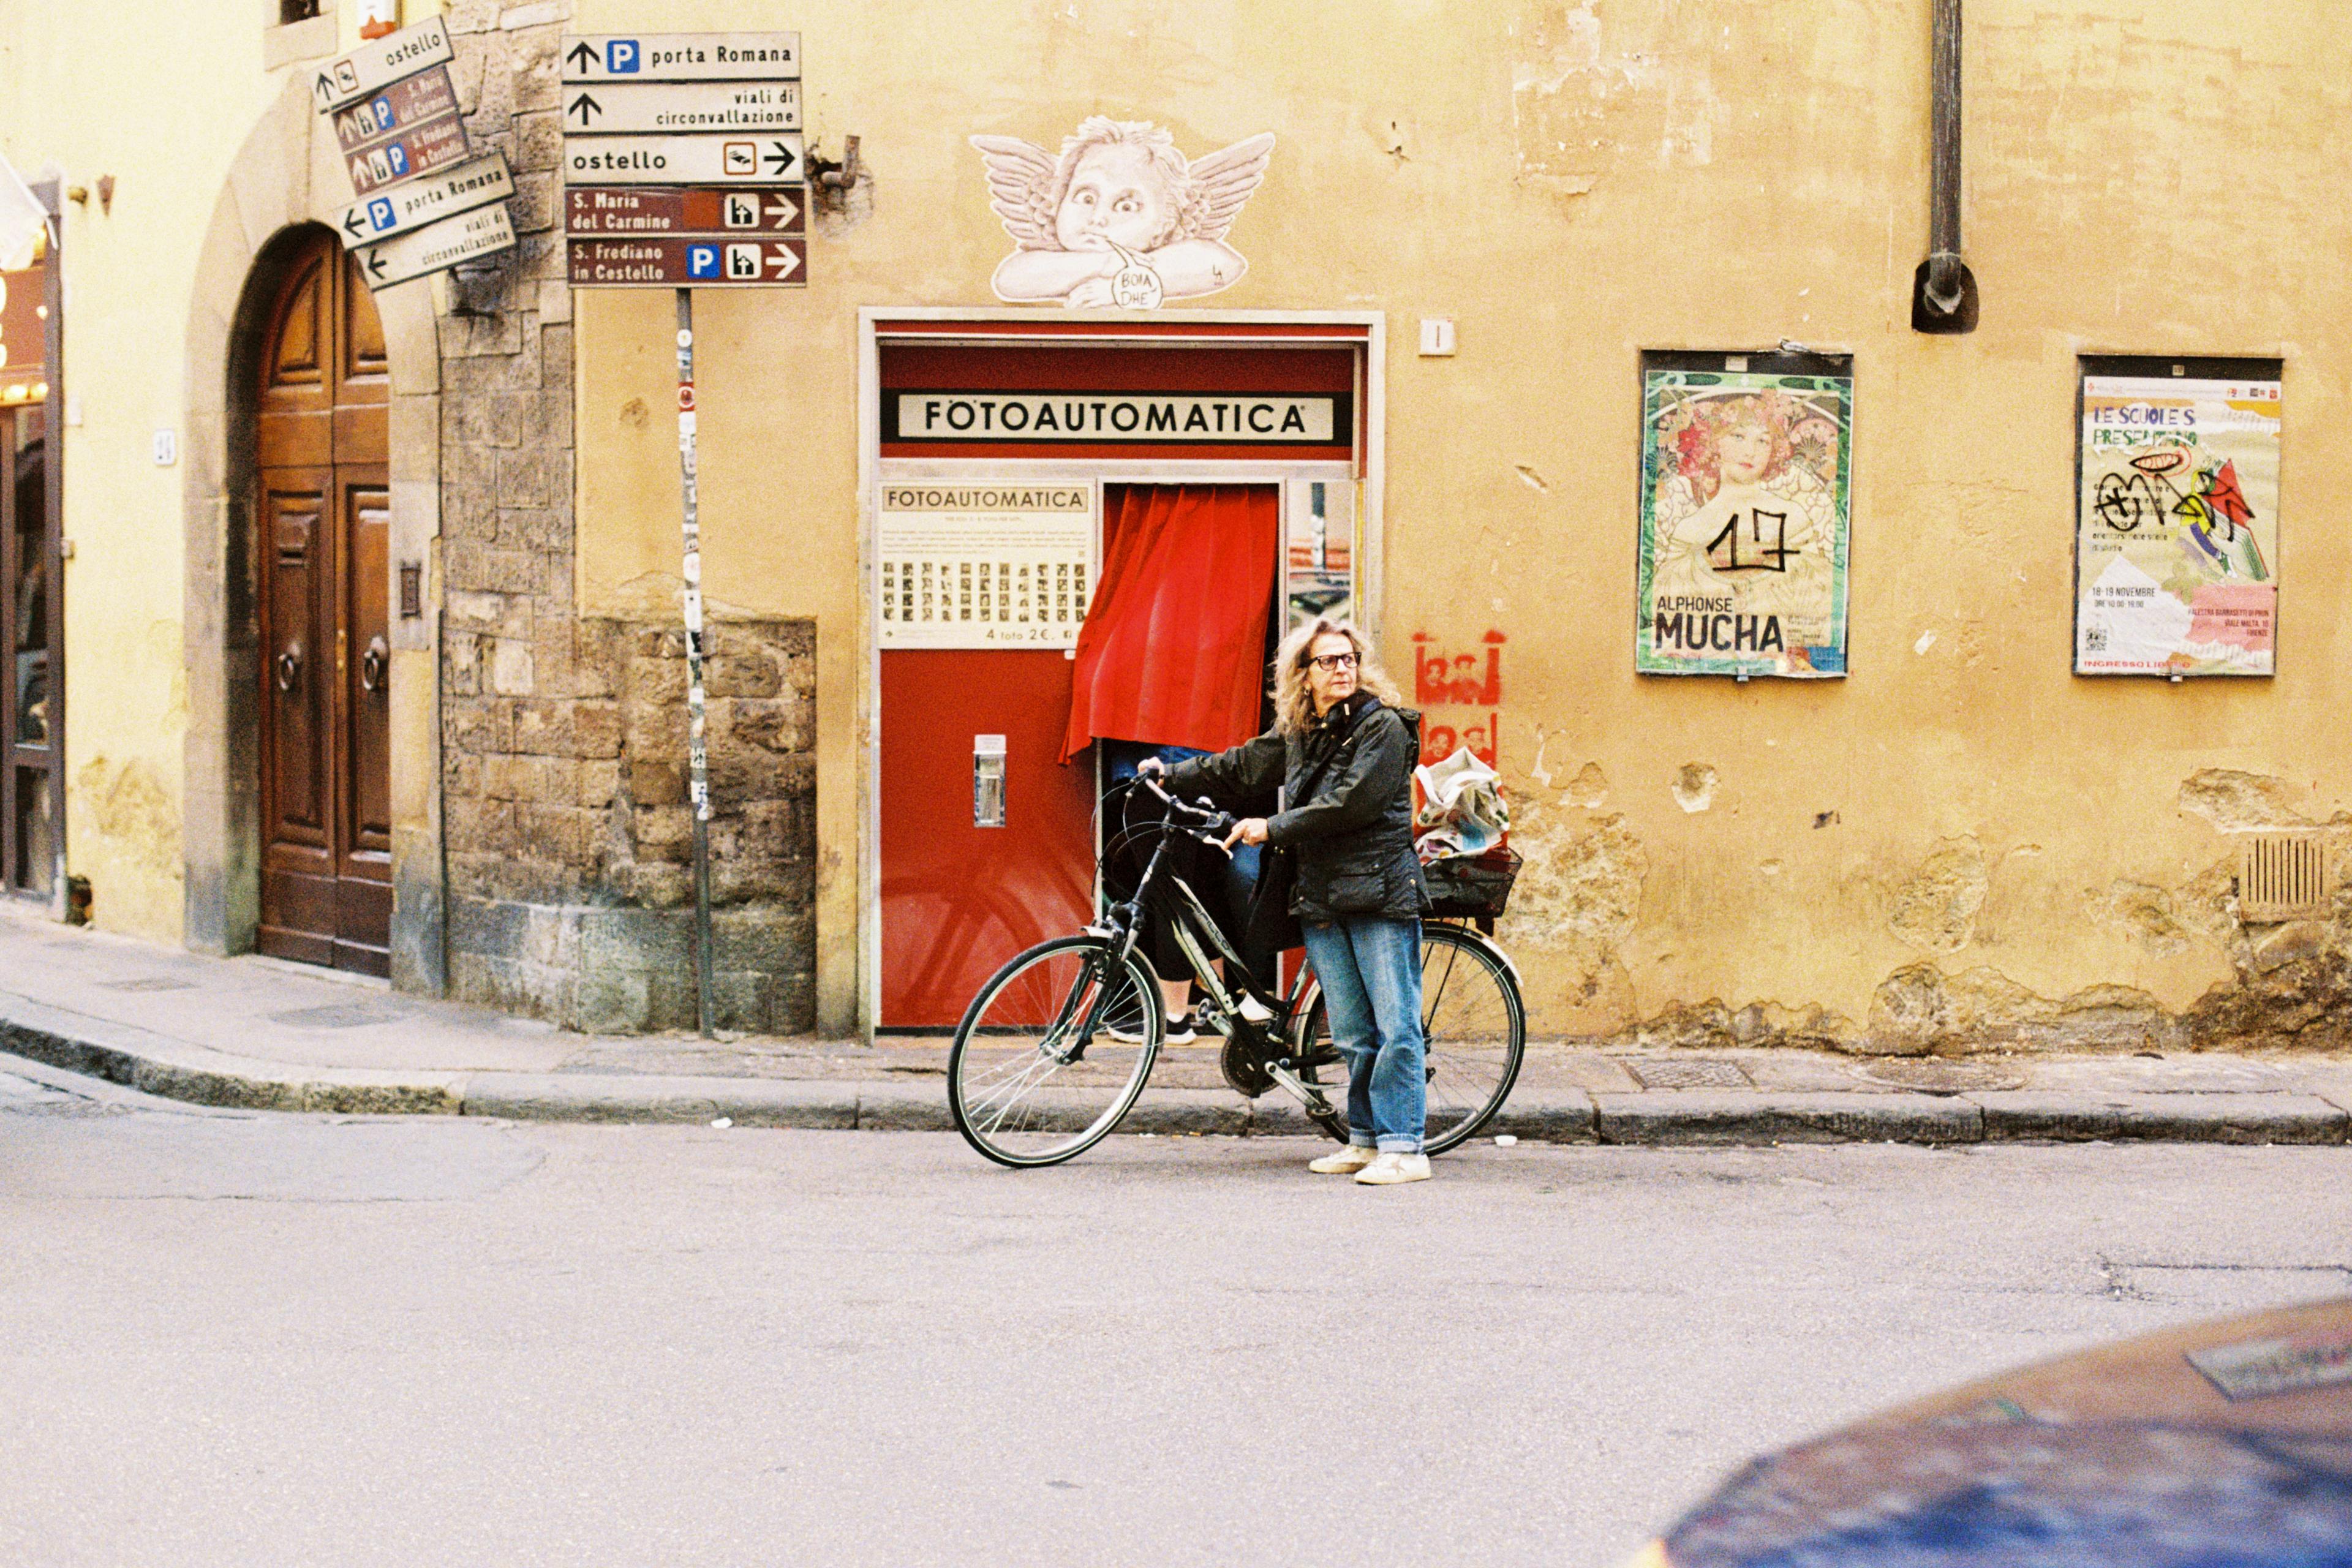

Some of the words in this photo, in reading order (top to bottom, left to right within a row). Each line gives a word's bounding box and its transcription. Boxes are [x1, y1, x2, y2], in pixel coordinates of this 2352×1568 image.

[386, 33, 440, 66] ostello
[652, 48, 705, 67] porta
[717, 46, 791, 62] Romana
[735, 90, 771, 104] viali
[780, 89, 793, 103] di
[657, 110, 793, 124] circonvallazione
[574, 151, 666, 169] ostello
[405, 189, 442, 214] porta
[449, 170, 502, 195] Romana
[574, 192, 589, 208] S.
[595, 192, 639, 208] Maria
[573, 213, 598, 229] del
[606, 213, 670, 229] Carmine
[575, 243, 589, 259] S.
[596, 243, 663, 259] Frediano
[575, 265, 589, 280] in
[926, 401, 1306, 433] FOTOAUTOMATICA
[2094, 407, 2114, 424] LE
[2119, 407, 2179, 425] SCUOLE
[889, 491, 1083, 507] FOTOAUTOMATICA
[2116, 587, 2155, 597] NOVEMBRE
[1657, 596, 1733, 612] ALPHONSE
[986, 628, 995, 640] 4
[1001, 631, 1023, 641] foto
[1656, 612, 1784, 652] MUCHA
